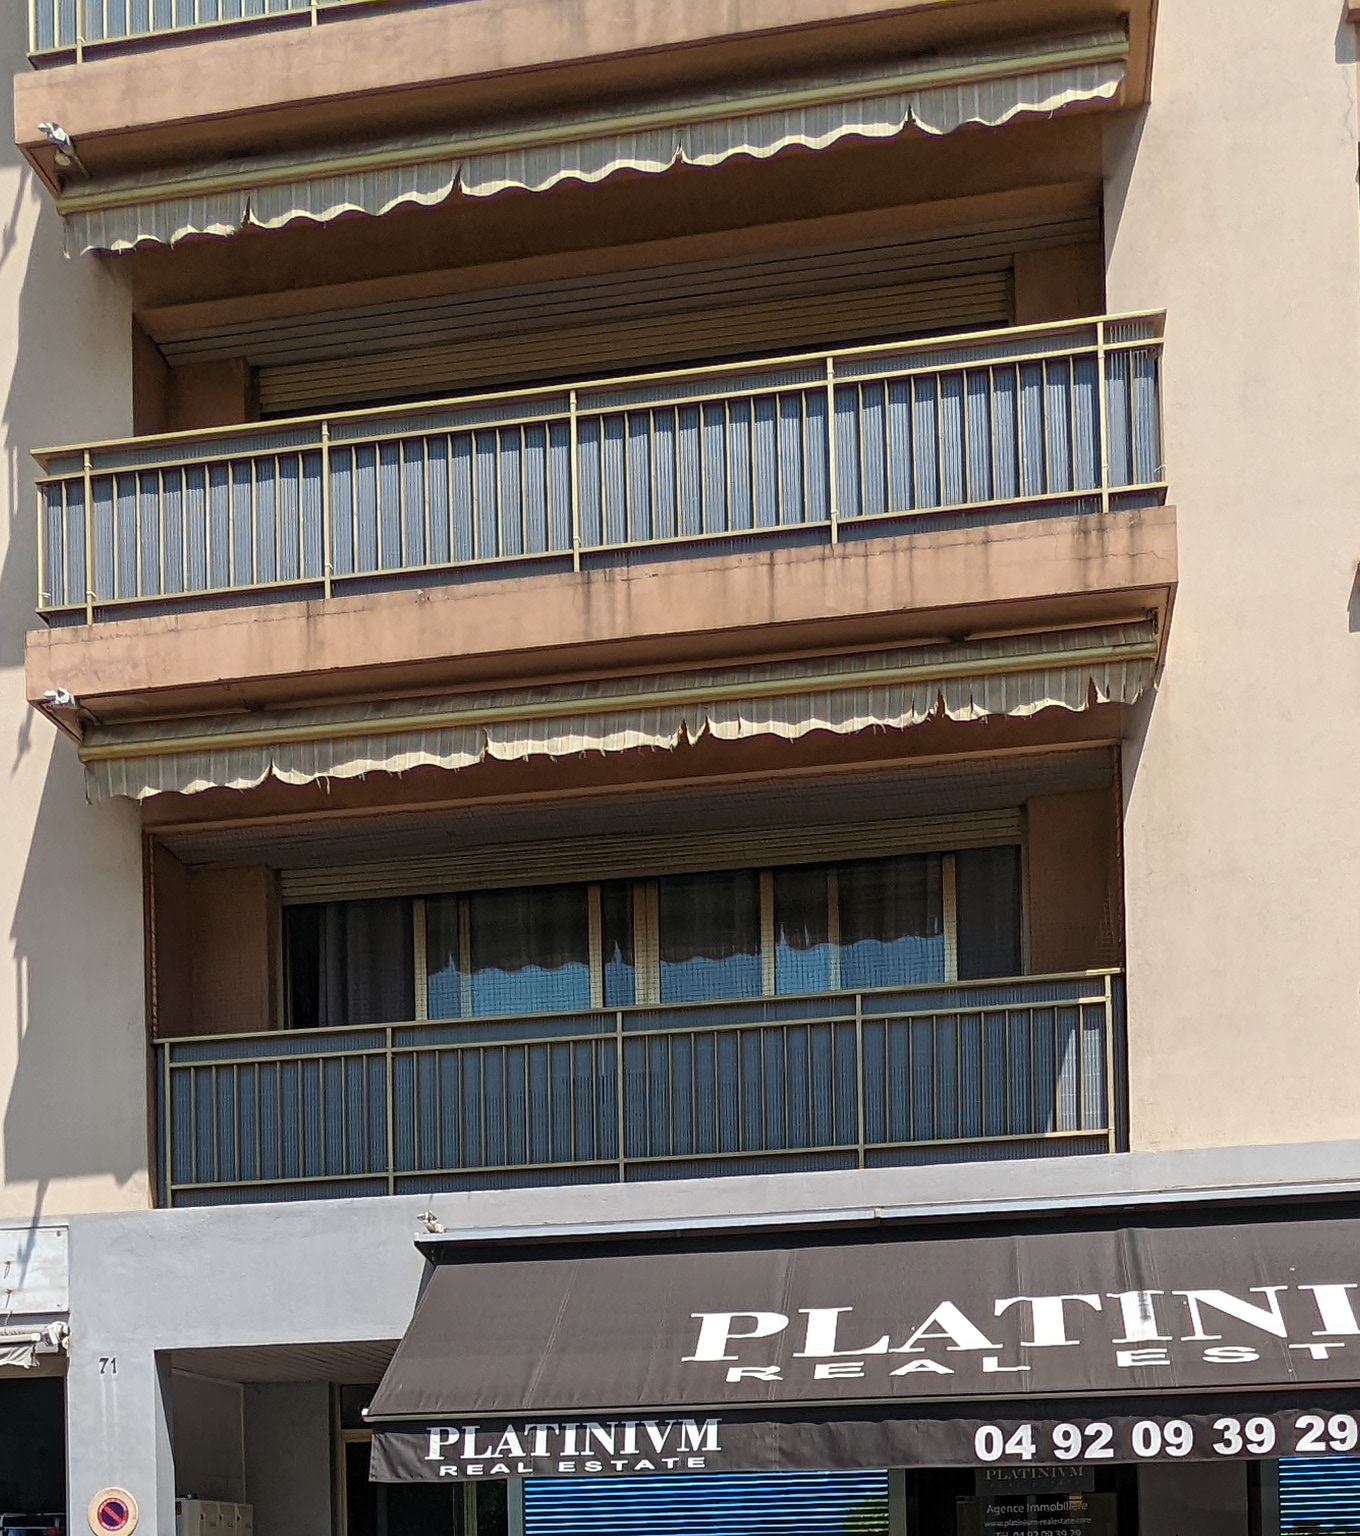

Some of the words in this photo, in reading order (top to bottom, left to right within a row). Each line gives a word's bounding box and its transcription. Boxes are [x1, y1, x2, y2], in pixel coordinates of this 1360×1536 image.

[99, 1357, 117, 1374] 71
[726, 1356, 1031, 1383] REAL
[425, 1418, 722, 1460] PLATINIVM
[974, 1424, 1036, 1461] 04
[1052, 1422, 1114, 1459] 92
[1131, 1420, 1193, 1457] 09
[1212, 1417, 1276, 1455] 39
[1295, 1415, 1358, 1452] 29
[440, 1461, 533, 1477] REAL
[559, 1457, 706, 1473] ESTATE
[986, 1504, 1025, 1516] Agence
